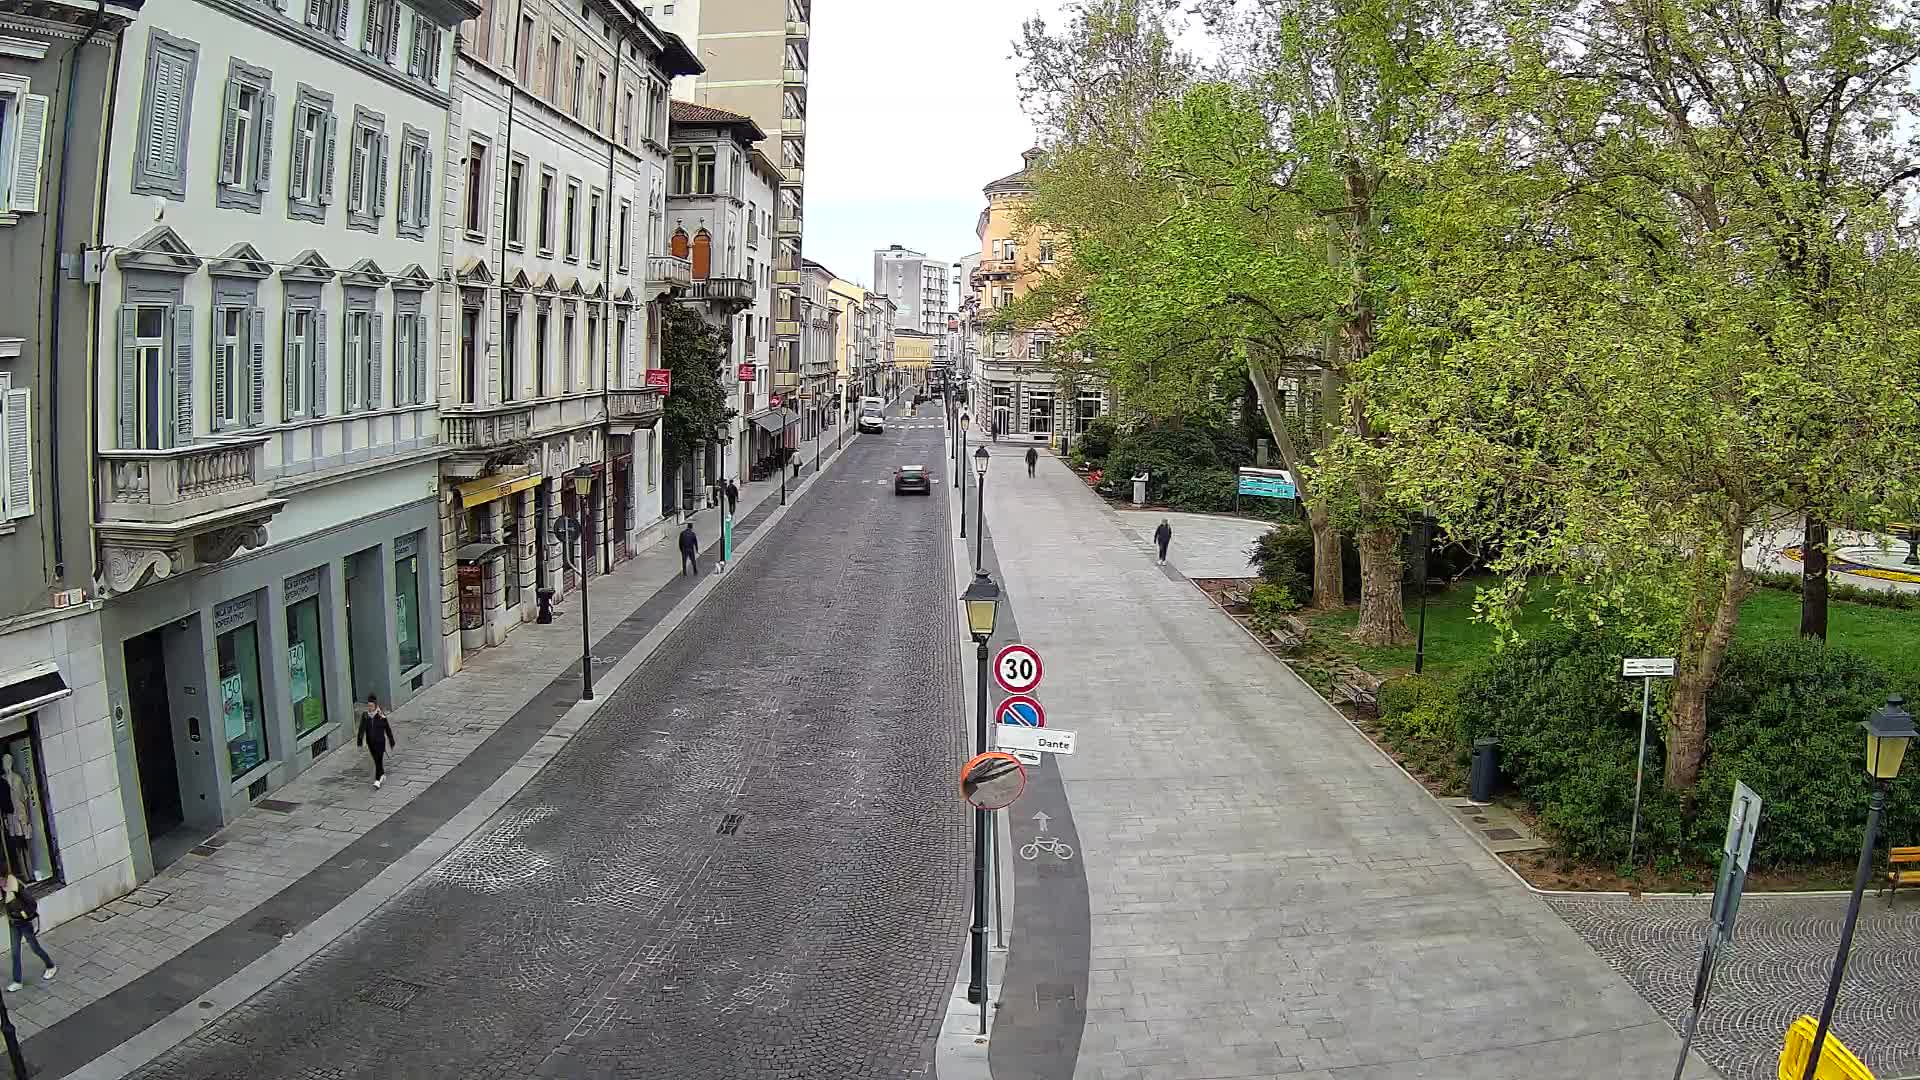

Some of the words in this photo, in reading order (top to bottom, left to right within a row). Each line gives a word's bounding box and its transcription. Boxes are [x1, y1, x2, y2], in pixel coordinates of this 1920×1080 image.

[1005, 659, 1033, 680] 30
[223, 678, 240, 700] 130
[1038, 738, 1070, 750] Dante
